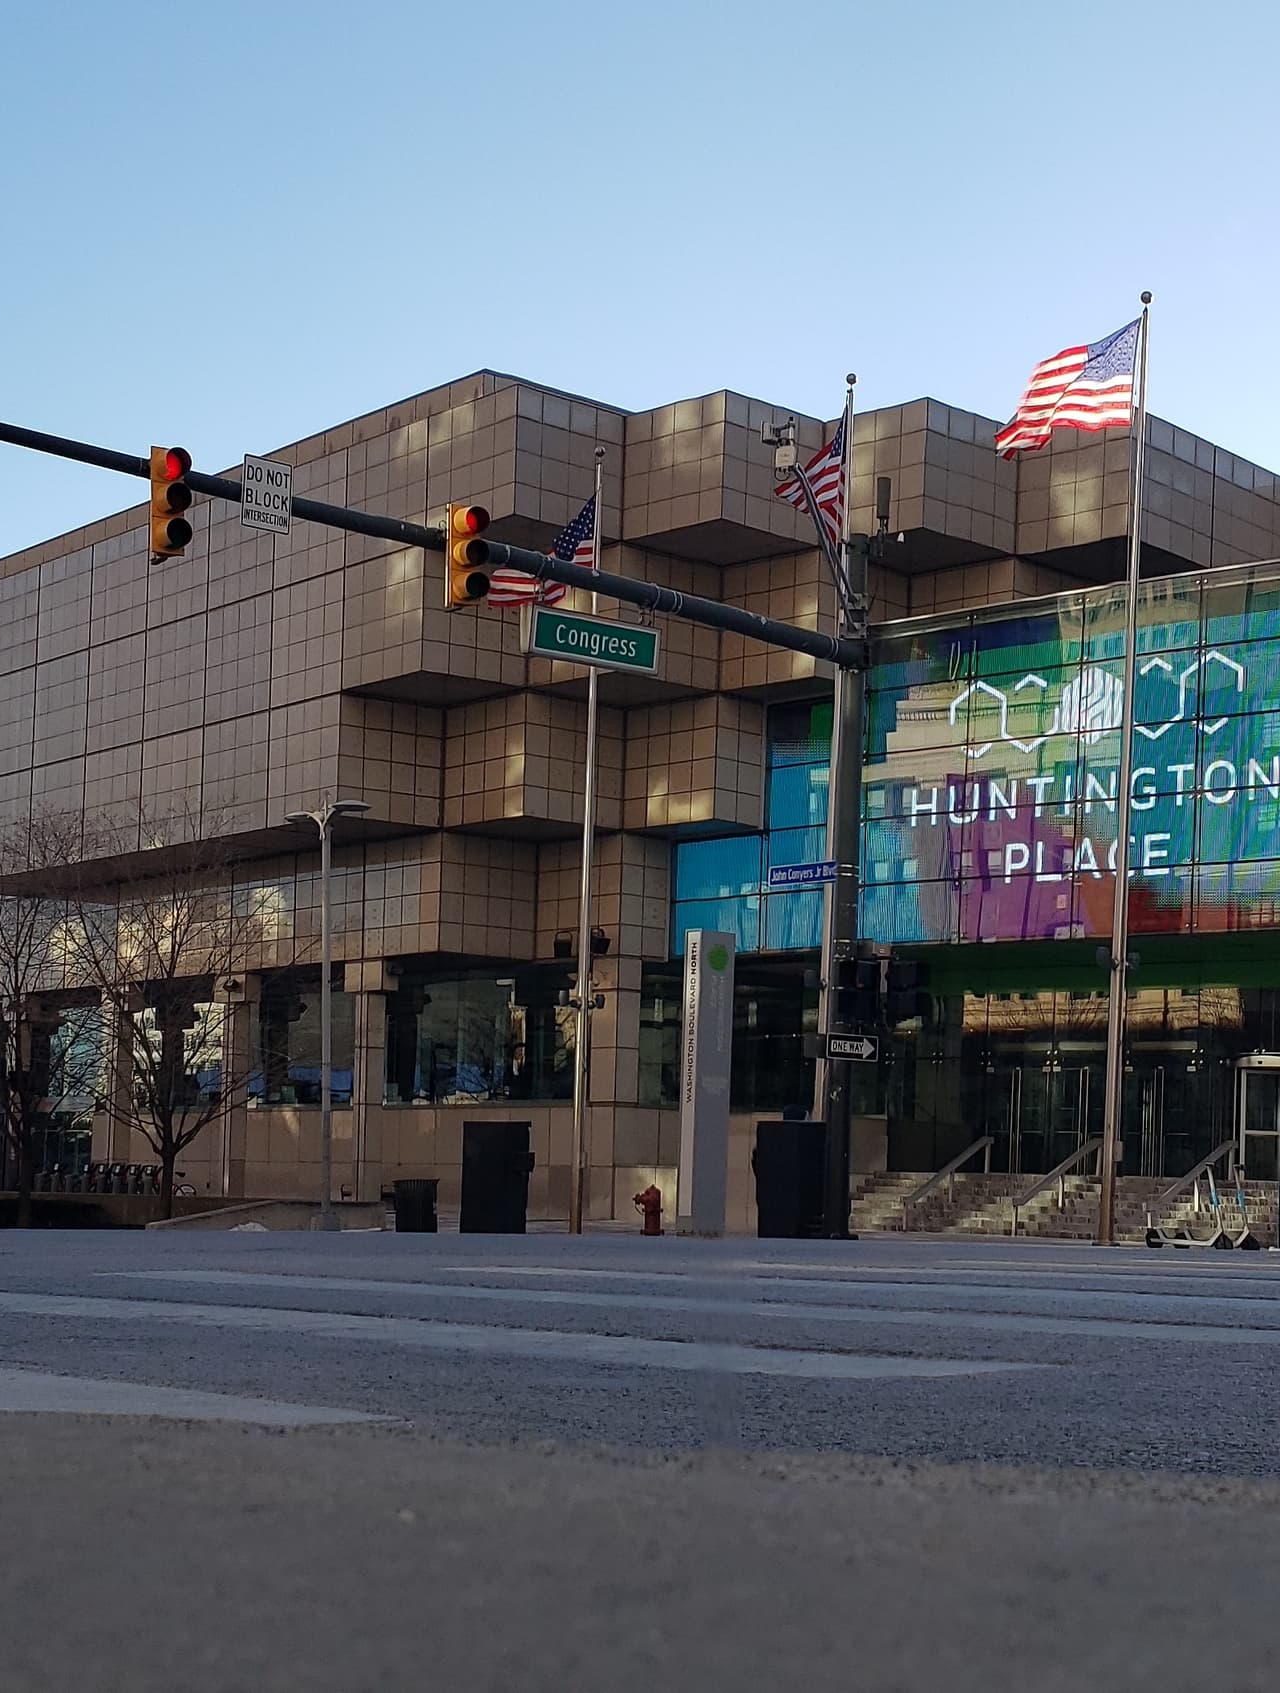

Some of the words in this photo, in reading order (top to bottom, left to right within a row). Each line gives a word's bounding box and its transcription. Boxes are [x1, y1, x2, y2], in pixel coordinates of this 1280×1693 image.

[246, 464, 263, 483] DO
[266, 469, 290, 489] NOT
[245, 487, 289, 513] BLOCK
[244, 508, 288, 528] INTERSECTION
[555, 623, 637, 657] Congress
[909, 755, 1280, 828] HUNTINGTON
[1003, 831, 1172, 885] PLACE
[771, 869, 787, 883] John
[788, 868, 813, 881] Conyers
[815, 866, 822, 878] Jr
[822, 864, 836, 877] Blv
[688, 977, 697, 1035] BOULEVARD
[832, 1040, 848, 1052] ONE
[849, 1042, 864, 1053] WAY
[686, 1038, 695, 1103] WASHINGTON
